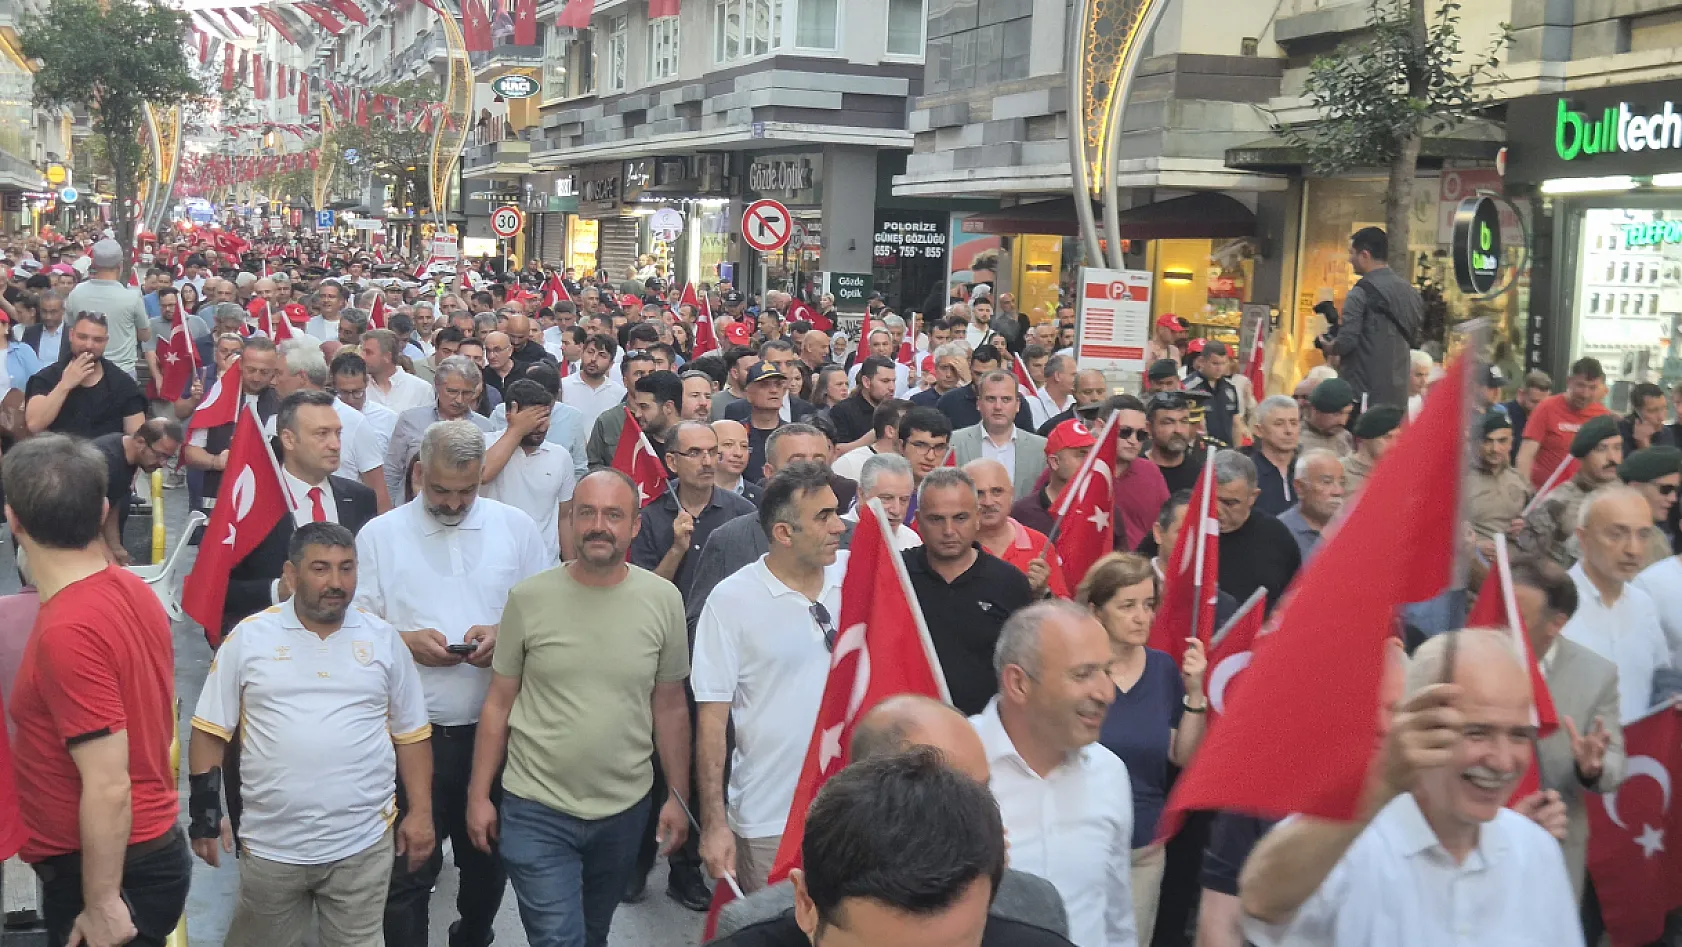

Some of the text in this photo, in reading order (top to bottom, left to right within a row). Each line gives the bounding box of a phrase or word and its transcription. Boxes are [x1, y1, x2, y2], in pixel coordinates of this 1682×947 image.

[1555, 97, 1682, 161] bulltech
[749, 159, 808, 198] Gözde Optik
[498, 214, 516, 229] 30
[874, 232, 904, 245] GÜNEŞ
[839, 276, 864, 287] Gözde
[840, 288, 863, 299] Optik
